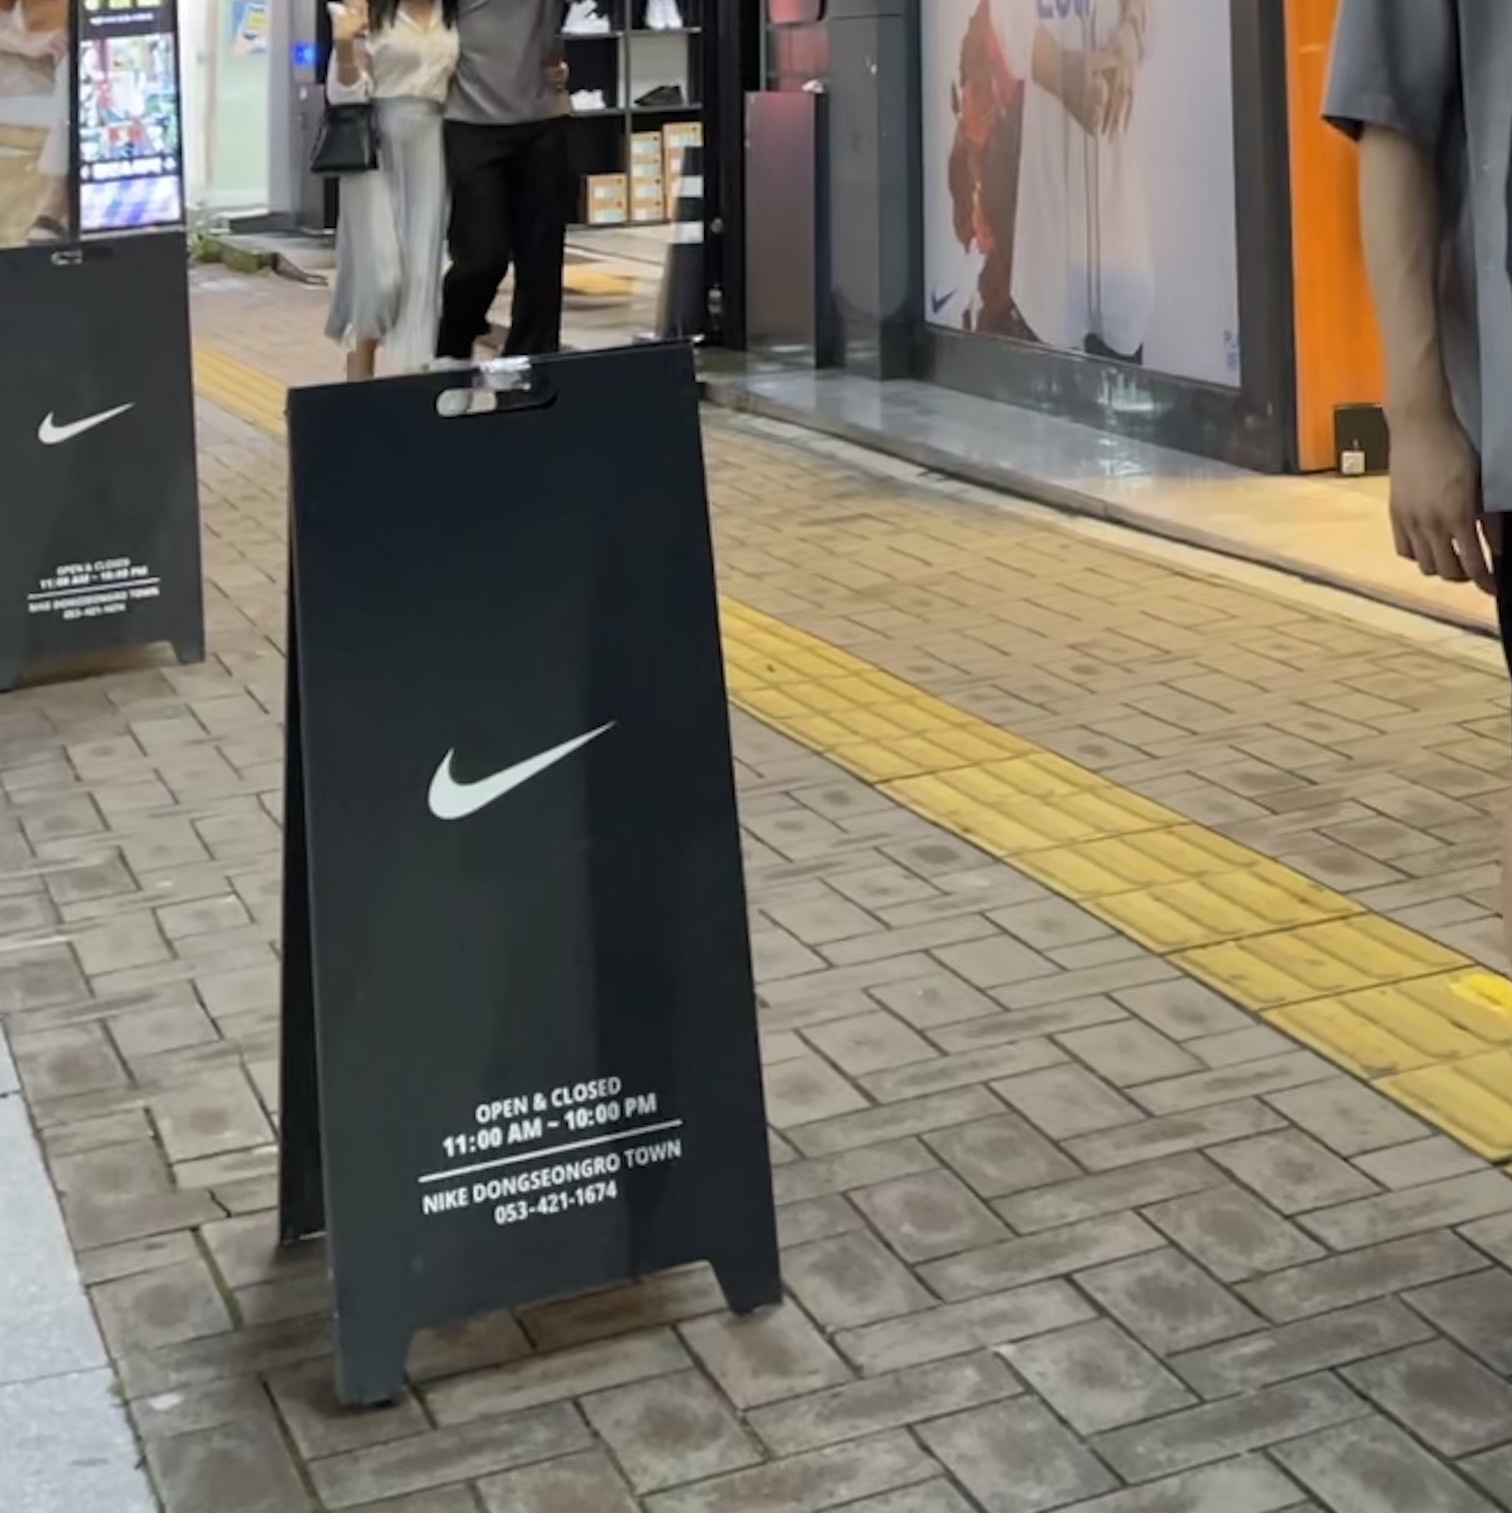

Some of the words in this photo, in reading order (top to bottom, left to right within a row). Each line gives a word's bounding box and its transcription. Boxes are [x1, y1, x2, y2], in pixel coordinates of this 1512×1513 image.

[442, 1126, 504, 1159] 11:00
[507, 1117, 543, 1146] AM
[563, 1102, 621, 1131] 10:00
[624, 1092, 658, 1119] PM
[475, 1096, 529, 1124] OPEN
[533, 1092, 548, 1111] &
[550, 1076, 623, 1109] CLOSED
[421, 1186, 470, 1216] NIKE
[472, 1152, 621, 1205] DONGSEONGRO
[623, 1139, 682, 1170] TOWN
[494, 1180, 619, 1226] 053-421-1674
